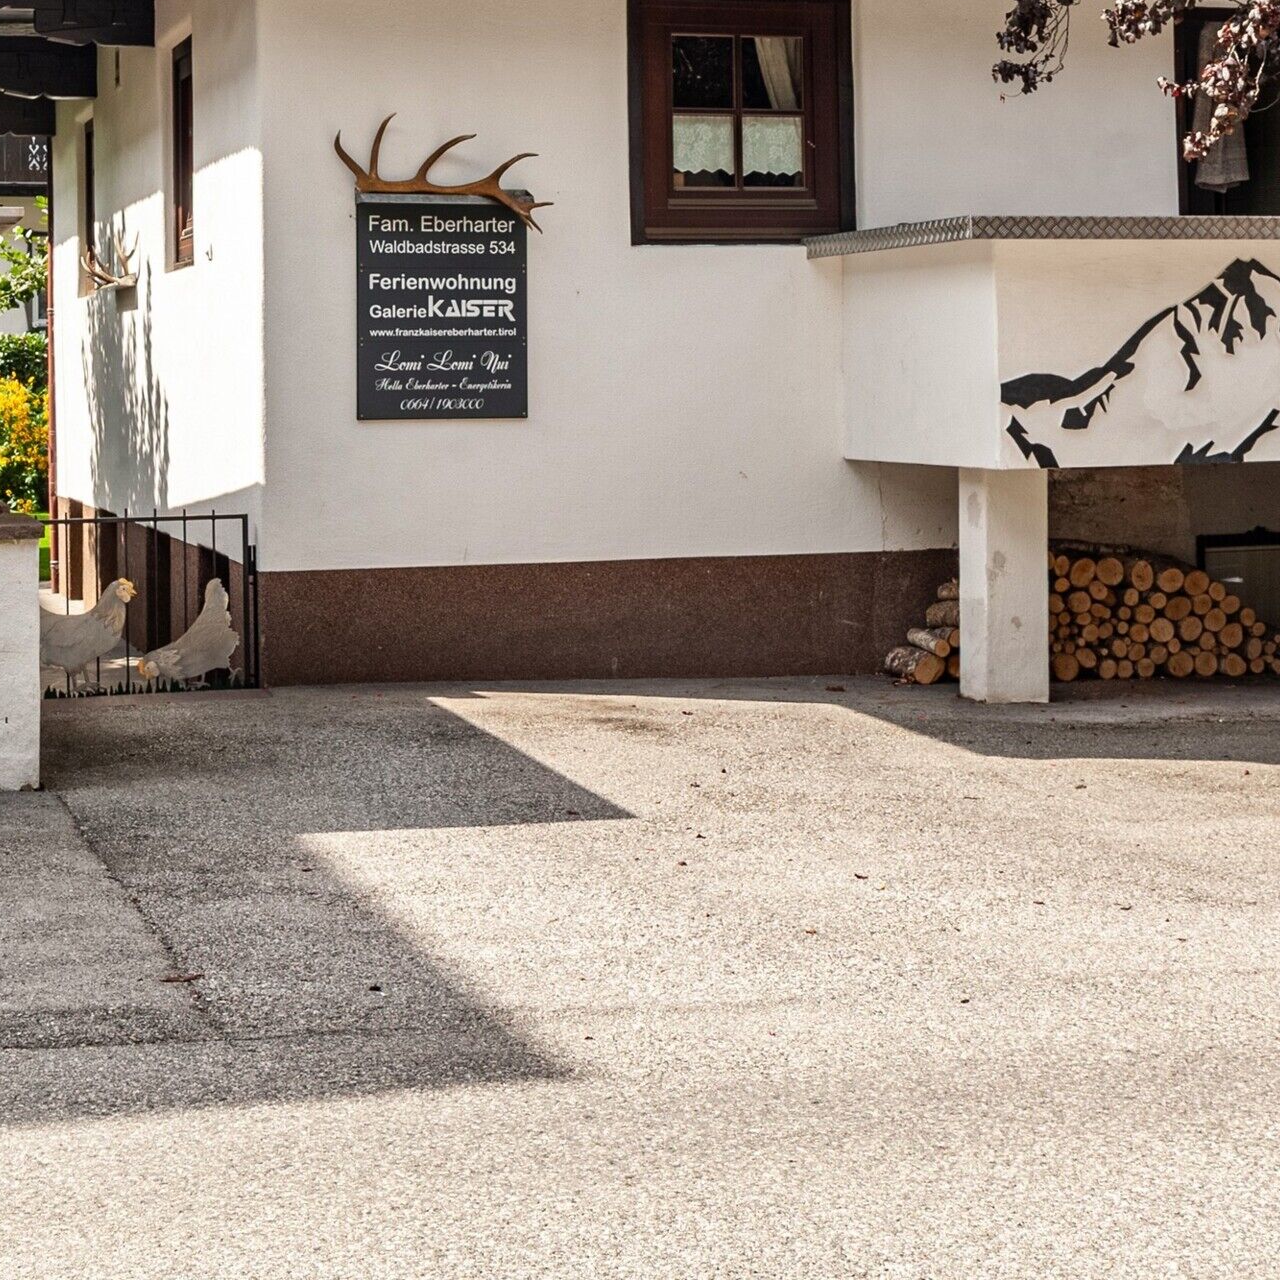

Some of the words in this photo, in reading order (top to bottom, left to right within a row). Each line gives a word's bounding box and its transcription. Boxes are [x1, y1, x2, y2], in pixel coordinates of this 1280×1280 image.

[369, 216, 413, 232] Fam.
[421, 216, 515, 233] Eberharter
[370, 240, 485, 255] Waldbadstrasse
[489, 241, 515, 254] 534
[369, 274, 516, 293] Ferienwohnung
[369, 327, 516, 337] www.franzkaisereberharter.tirol
[374, 349, 424, 371] Lomi
[426, 349, 476, 371] Lomi
[480, 350, 512, 374] Nui
[375, 378, 402, 391] Hella
[405, 377, 449, 390] Eberharter
[459, 377, 512, 392] Energetikerin
